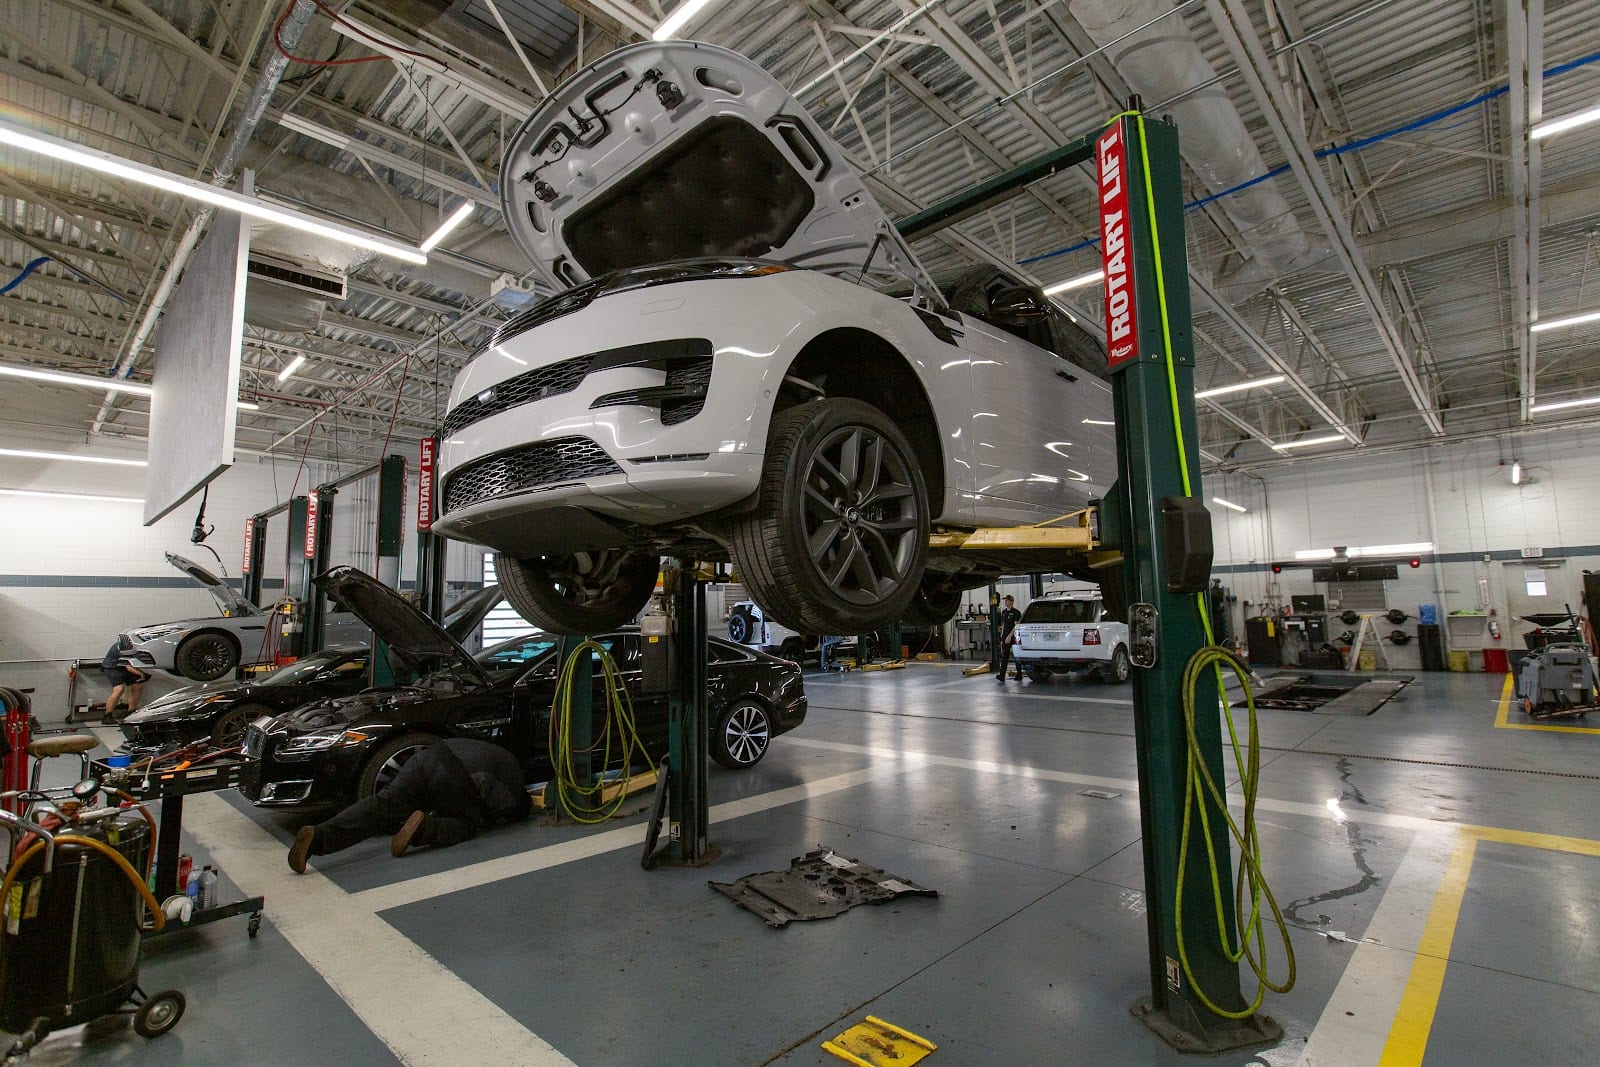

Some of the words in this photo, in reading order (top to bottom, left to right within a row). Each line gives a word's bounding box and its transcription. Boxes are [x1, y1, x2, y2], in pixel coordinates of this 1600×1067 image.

[1101, 132, 1122, 205] LIFT
[1104, 209, 1131, 342] ROTARY
[422, 440, 432, 467] LIFT
[420, 469, 431, 521] ROTARY
[306, 513, 316, 551] ROTARY
